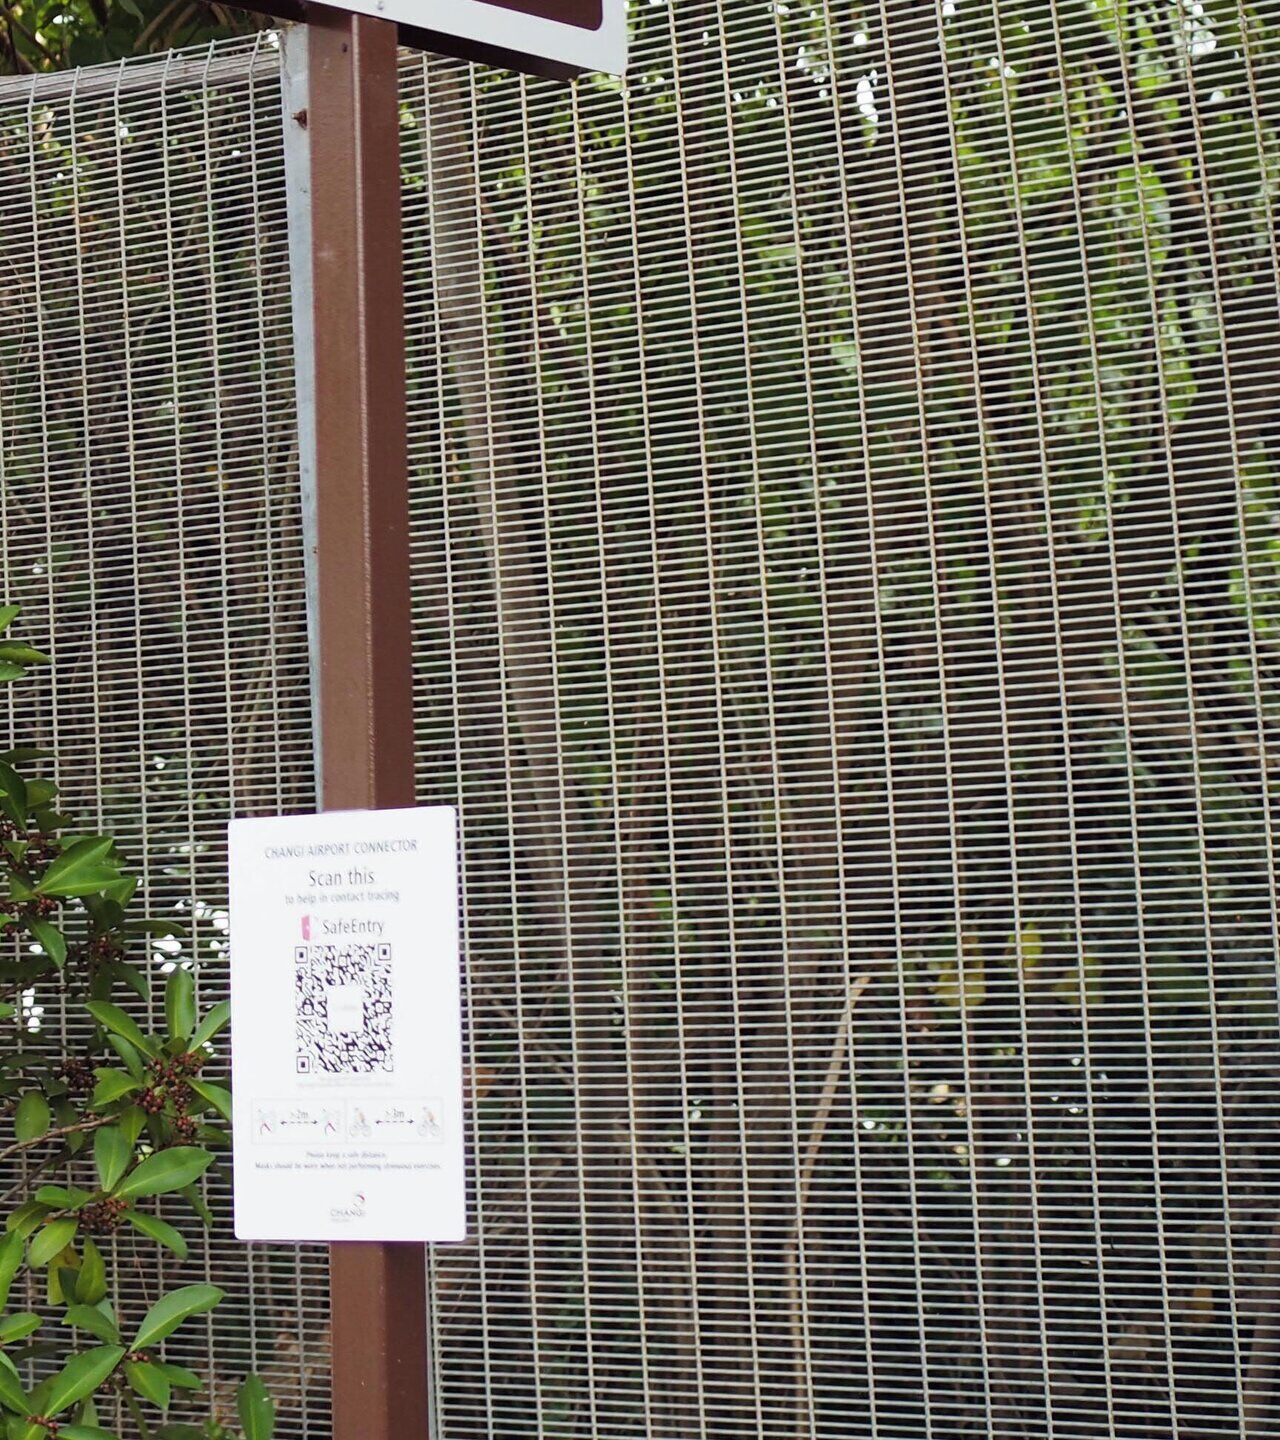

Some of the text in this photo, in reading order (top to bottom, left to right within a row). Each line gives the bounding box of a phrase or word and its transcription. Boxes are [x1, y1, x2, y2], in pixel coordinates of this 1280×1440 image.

[264, 838, 418, 860] CHANGI AIRPORT CONNECTOR
[308, 865, 375, 887] Scan this
[330, 891, 364, 903] contact
[322, 918, 384, 937] SafeEntry
